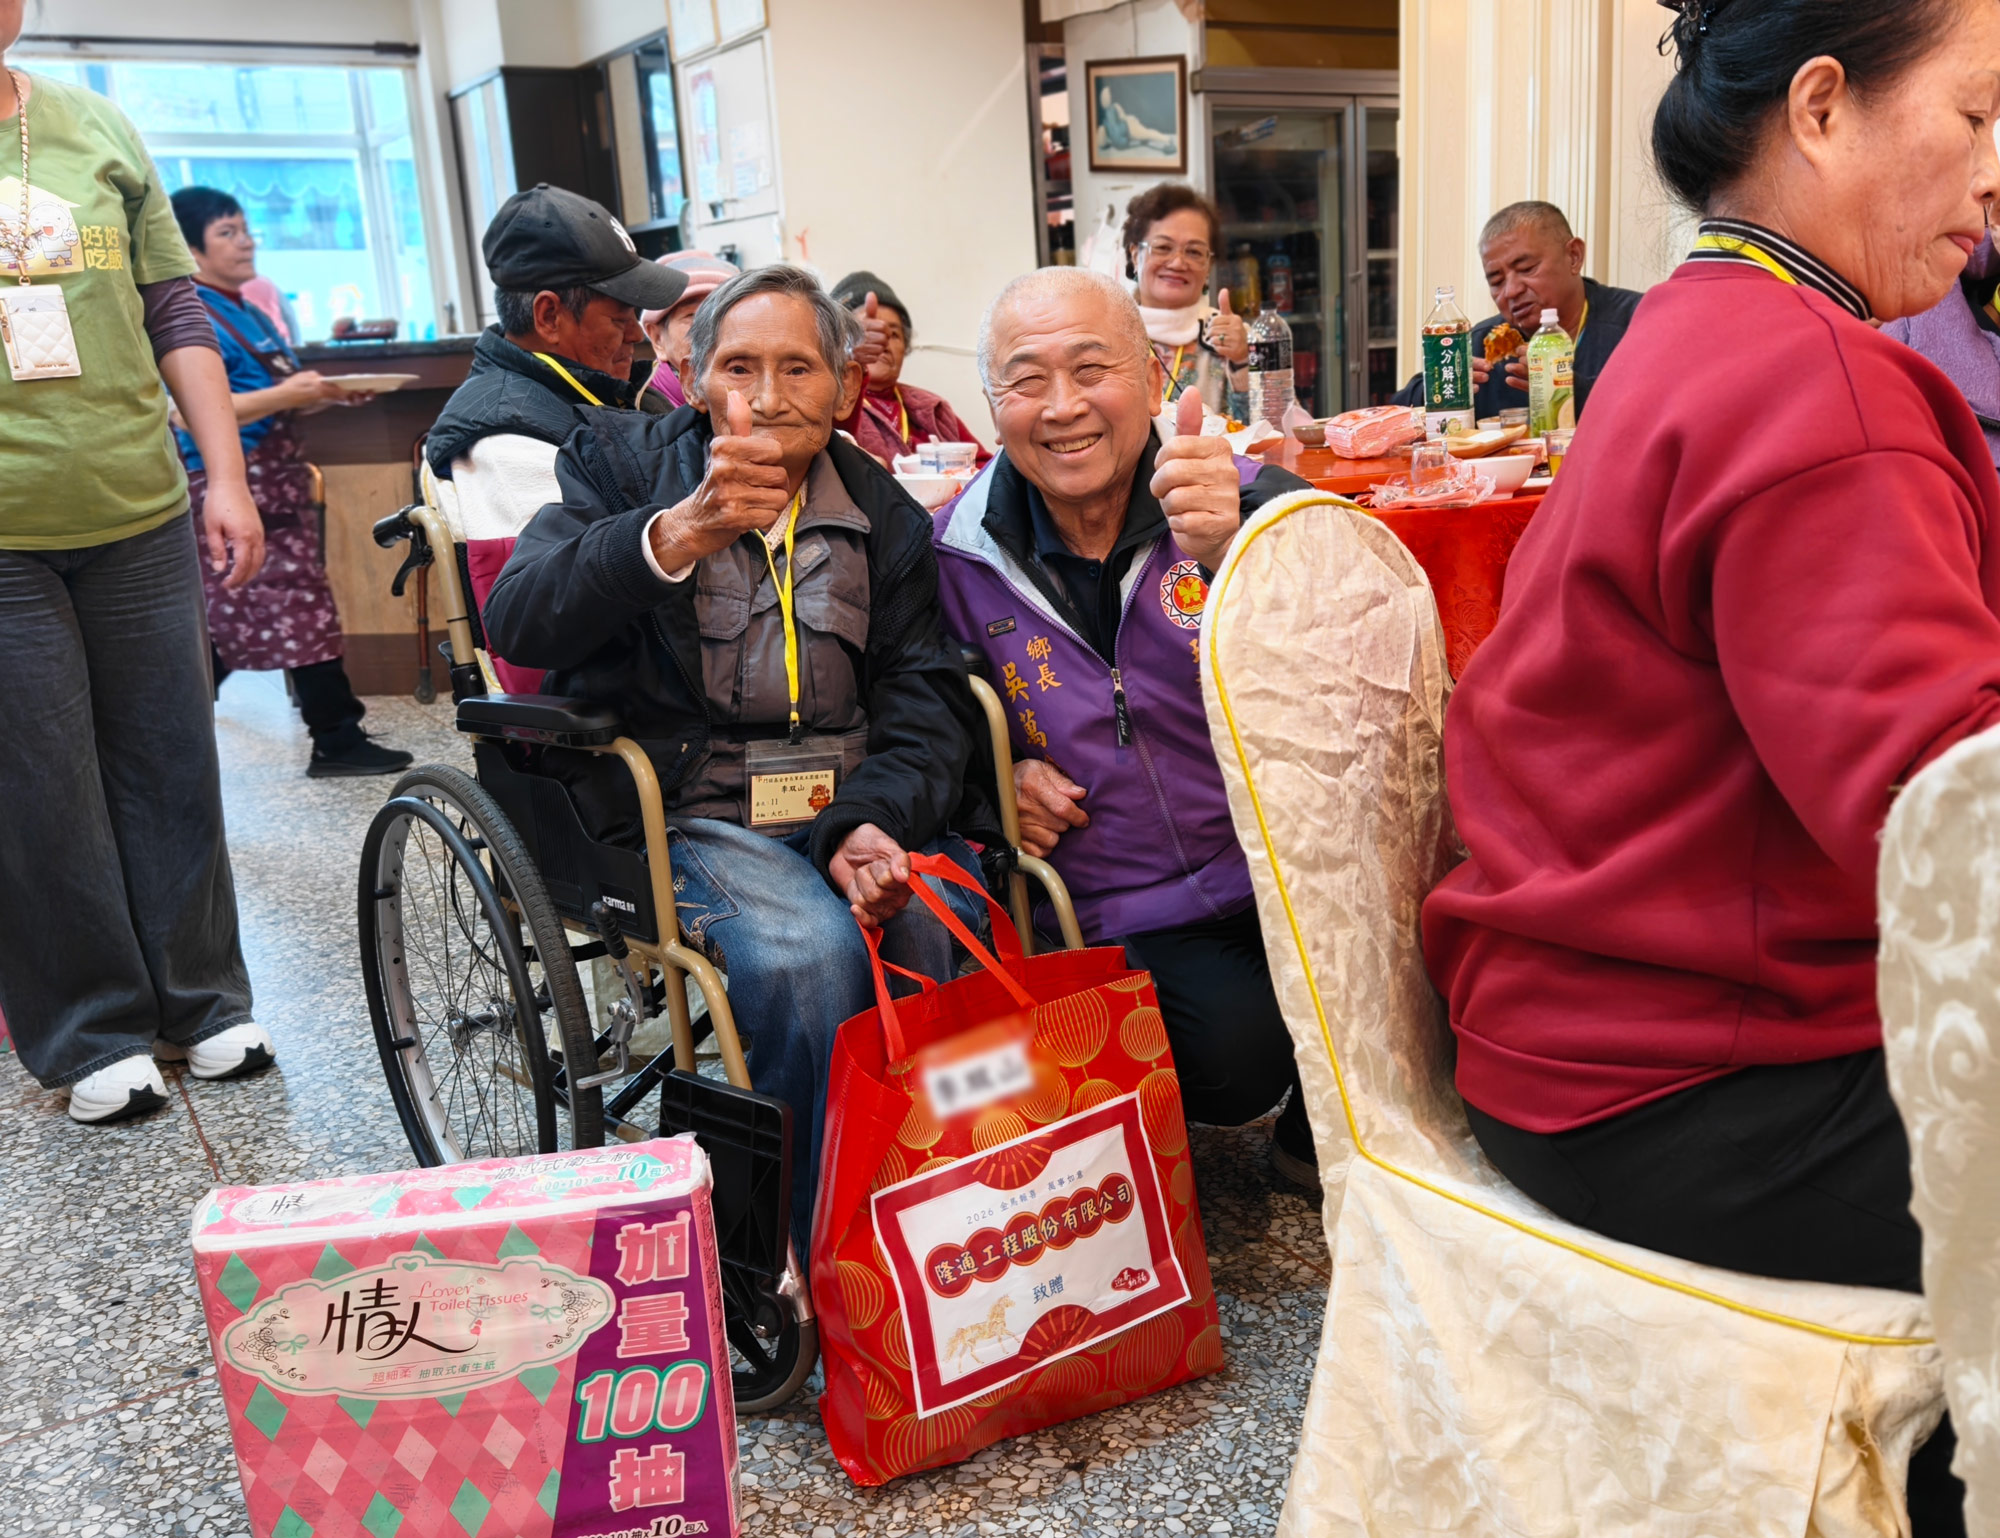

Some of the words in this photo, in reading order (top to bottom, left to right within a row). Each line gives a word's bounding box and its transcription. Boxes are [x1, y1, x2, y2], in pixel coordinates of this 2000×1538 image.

[81, 226, 119, 248] 好好
[86, 248, 124, 271] 吃飯
[1441, 349, 1455, 399] 分解茶
[1026, 635, 1063, 692] 鄉長
[966, 1208, 994, 1225] 2026
[1048, 1169, 1084, 1191] 萬事如意
[934, 1182, 1132, 1285] 隆通工程股份有限公司
[409, 1281, 474, 1299] Lover
[430, 1297, 472, 1312] Toilet
[477, 1291, 529, 1308] Tissues
[1032, 1274, 1064, 1304] 致贈
[319, 1278, 479, 1360] 情人
[418, 1360, 496, 1379] 抽取式衛生紙
